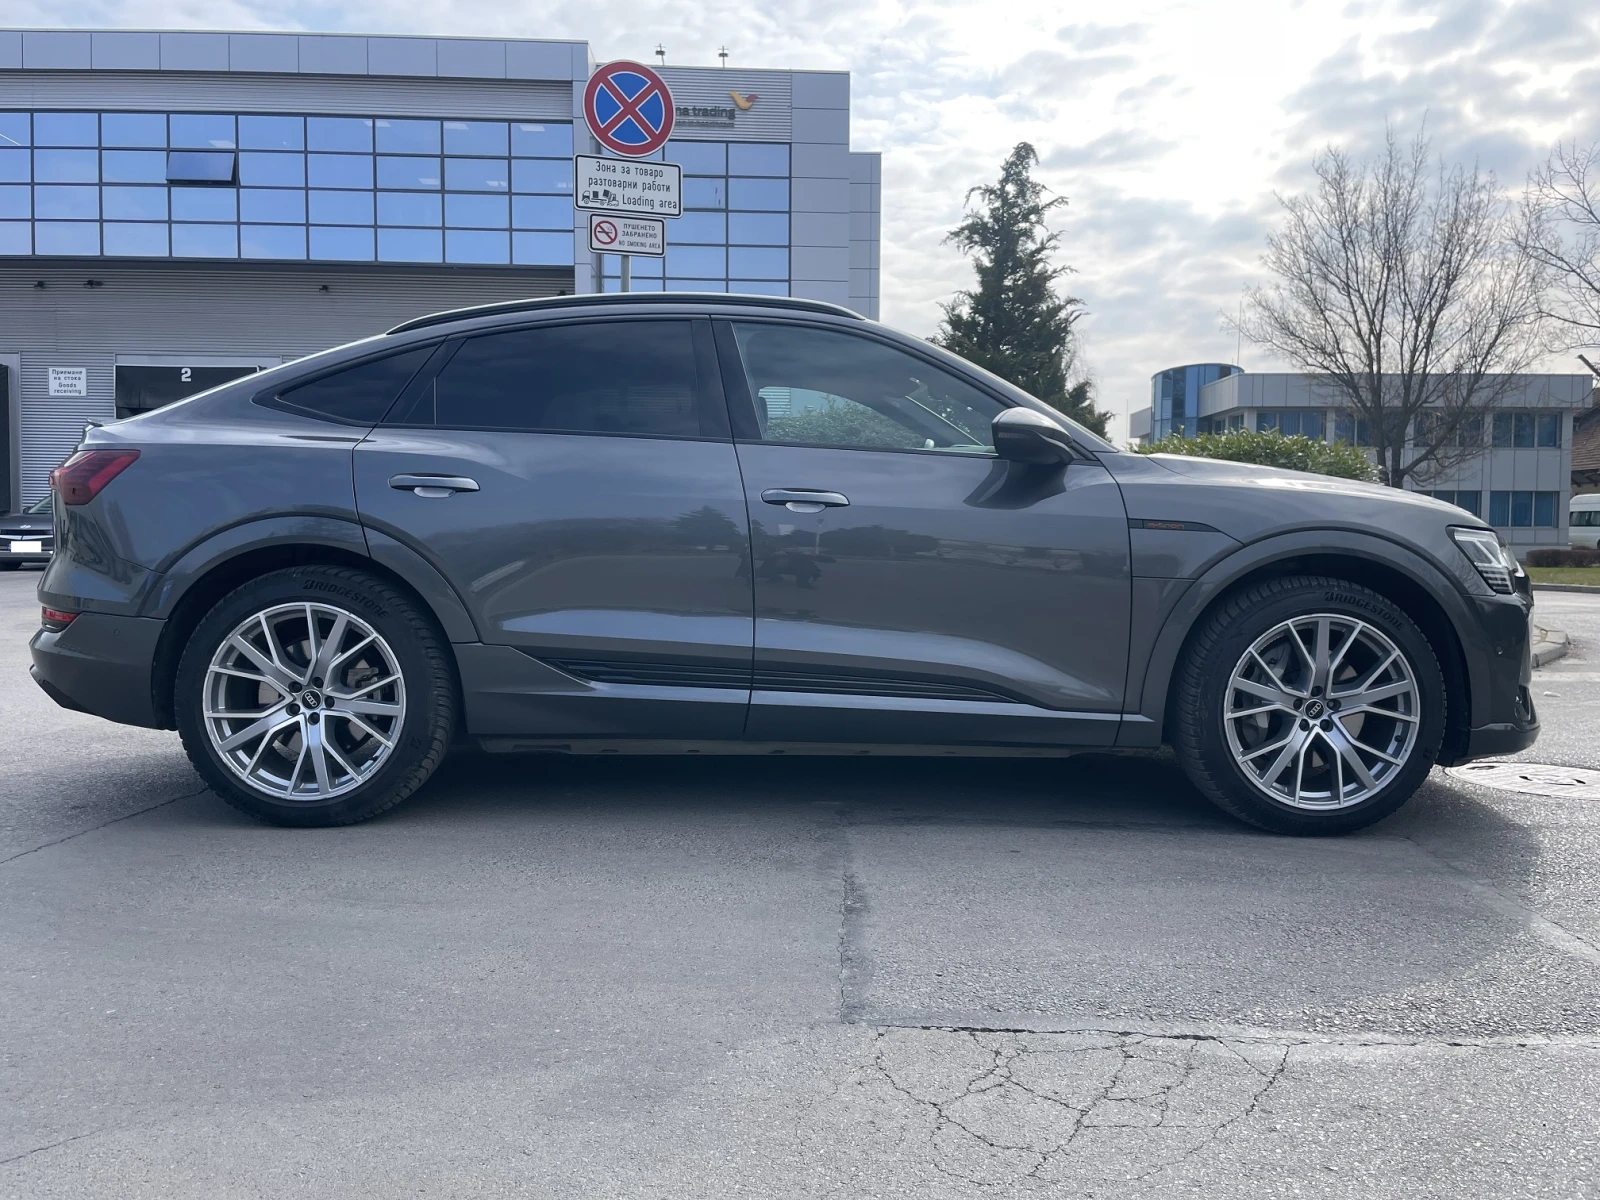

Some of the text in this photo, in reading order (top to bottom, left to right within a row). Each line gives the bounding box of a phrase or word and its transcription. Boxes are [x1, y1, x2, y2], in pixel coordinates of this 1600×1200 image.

[692, 106, 736, 120] trading
[595, 161, 664, 179] Зона за товаро
[588, 177, 671, 192] разтоварни работи
[622, 194, 677, 210] Loading area
[621, 230, 658, 239] ЗАБРАНЕНО
[623, 223, 656, 231] ПУШЕНЕТО
[626, 240, 647, 248] SMOKING
[181, 367, 192, 382] 2
[302, 579, 389, 619] BRIDGESTONE
[1323, 591, 1404, 631] BRIDGESTONE
